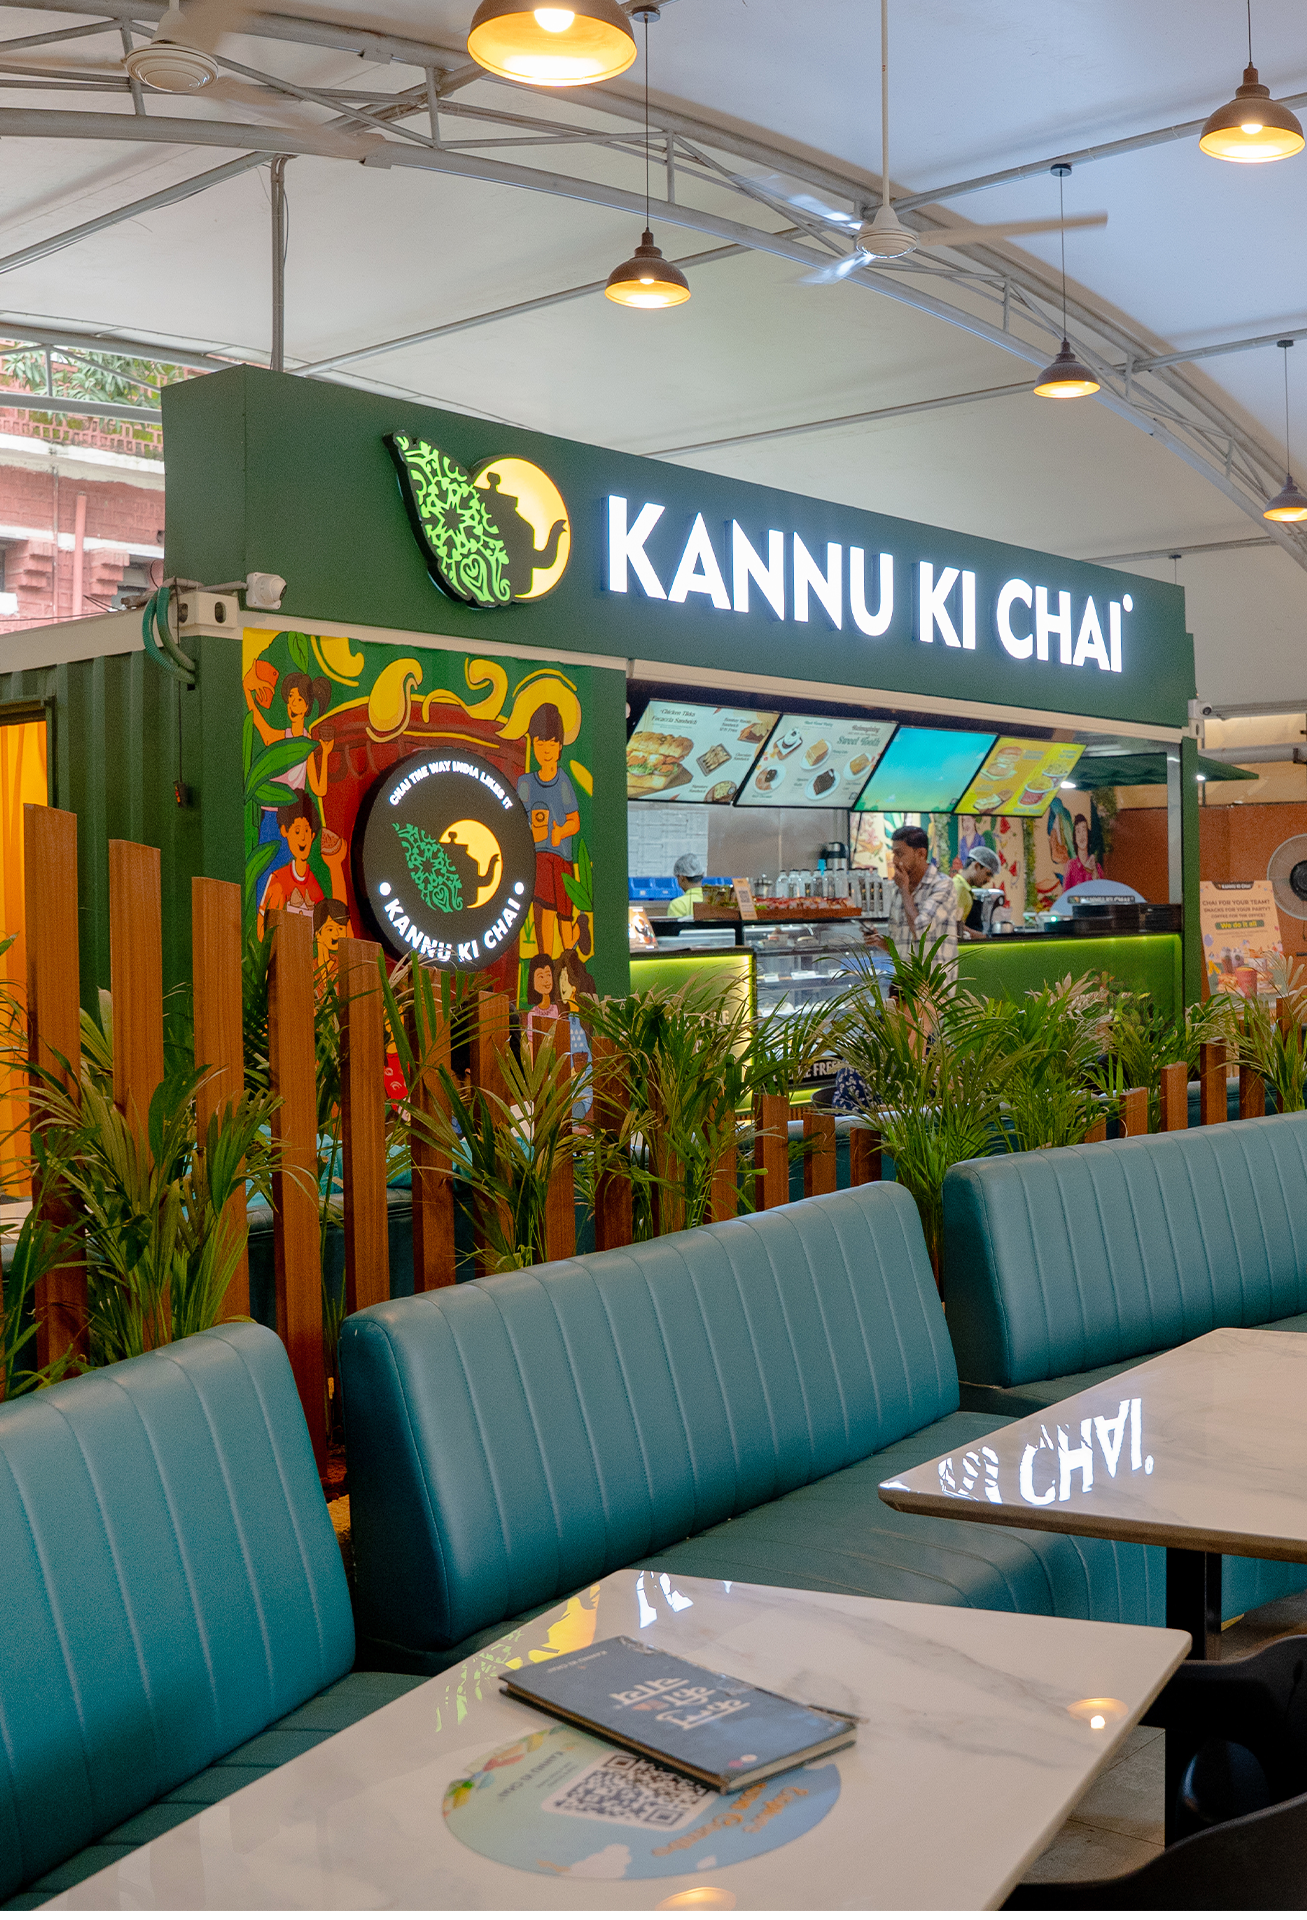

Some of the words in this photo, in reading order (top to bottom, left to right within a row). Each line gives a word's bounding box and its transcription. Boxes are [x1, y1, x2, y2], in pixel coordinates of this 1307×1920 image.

[608, 494, 893, 637] KANNU
[919, 560, 976, 650] KI
[997, 578, 1122, 673] CHAI
[837, 735, 860, 745] Sweet
[861, 736, 880, 747] Tooth
[389, 778, 412, 806] CHAI
[408, 765, 429, 785] THE
[428, 760, 451, 774] WAY
[451, 761, 479, 779] INDIA
[480, 771, 505, 800] LIKES
[501, 796, 513, 809] IT
[384, 898, 452, 962] KANNU
[457, 939, 480, 963] KI
[483, 897, 521, 949] CHAI
[609, 1677, 690, 1707] चाय
[661, 1686, 716, 1707] की
[655, 1700, 750, 1730] कन्नु
